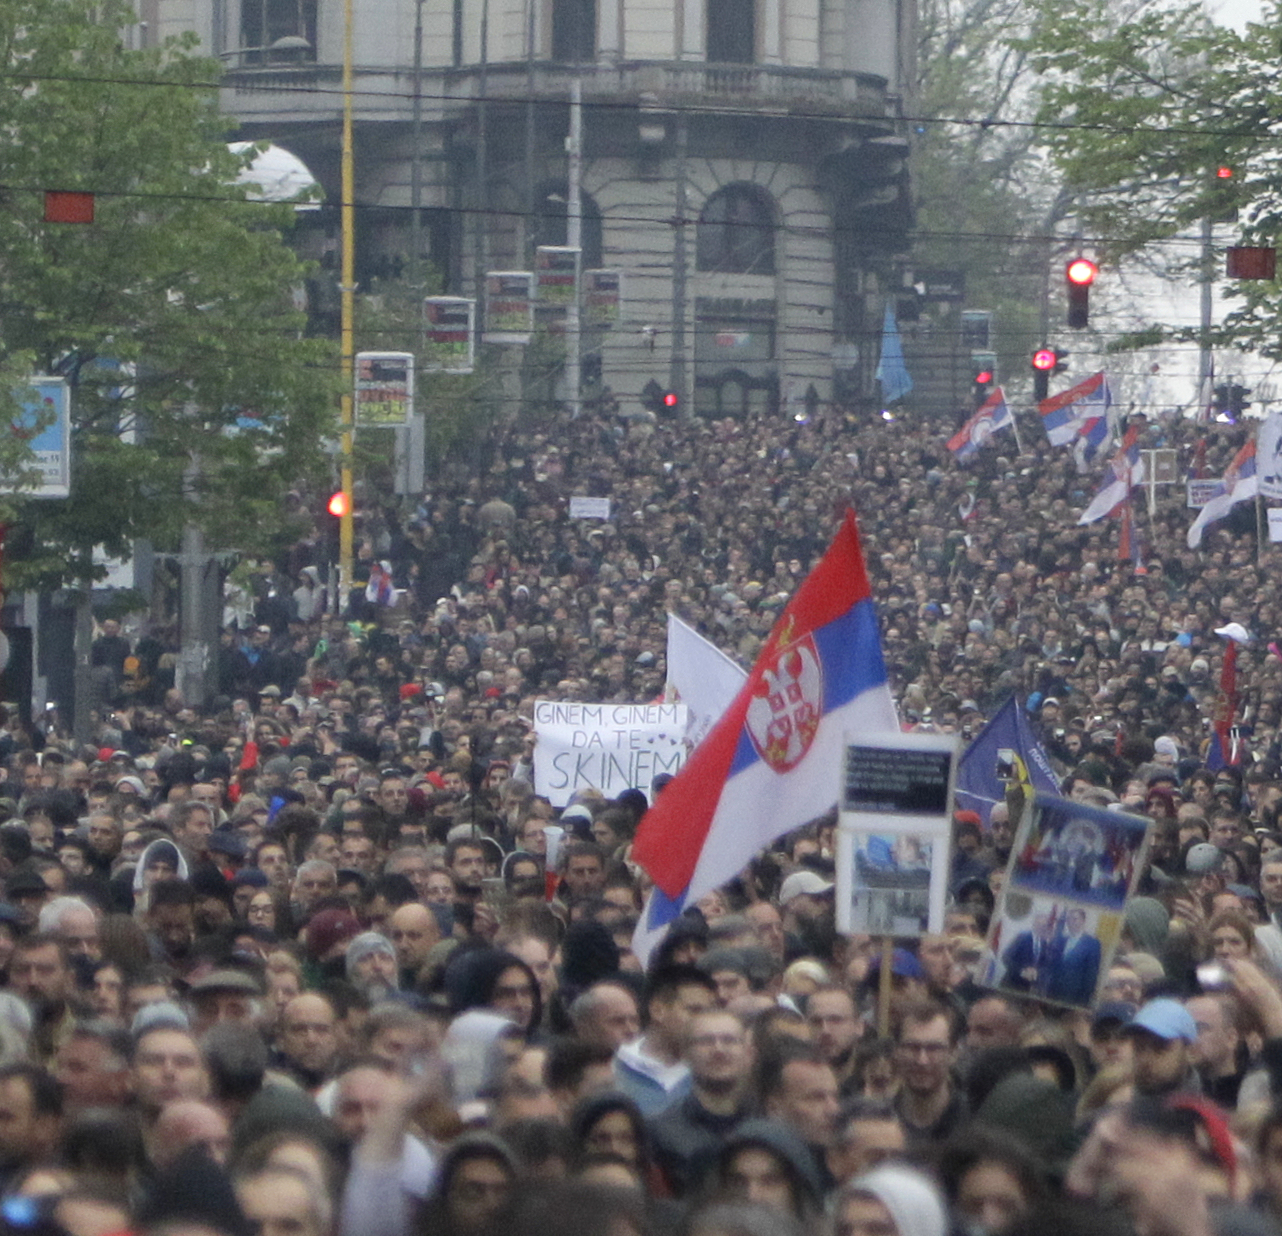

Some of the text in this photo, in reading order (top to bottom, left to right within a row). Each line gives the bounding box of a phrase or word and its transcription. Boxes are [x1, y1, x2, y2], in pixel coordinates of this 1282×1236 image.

[612, 705, 677, 724] GINEM
[572, 729, 641, 749] DA TE
[548, 751, 680, 789] SKINEM
